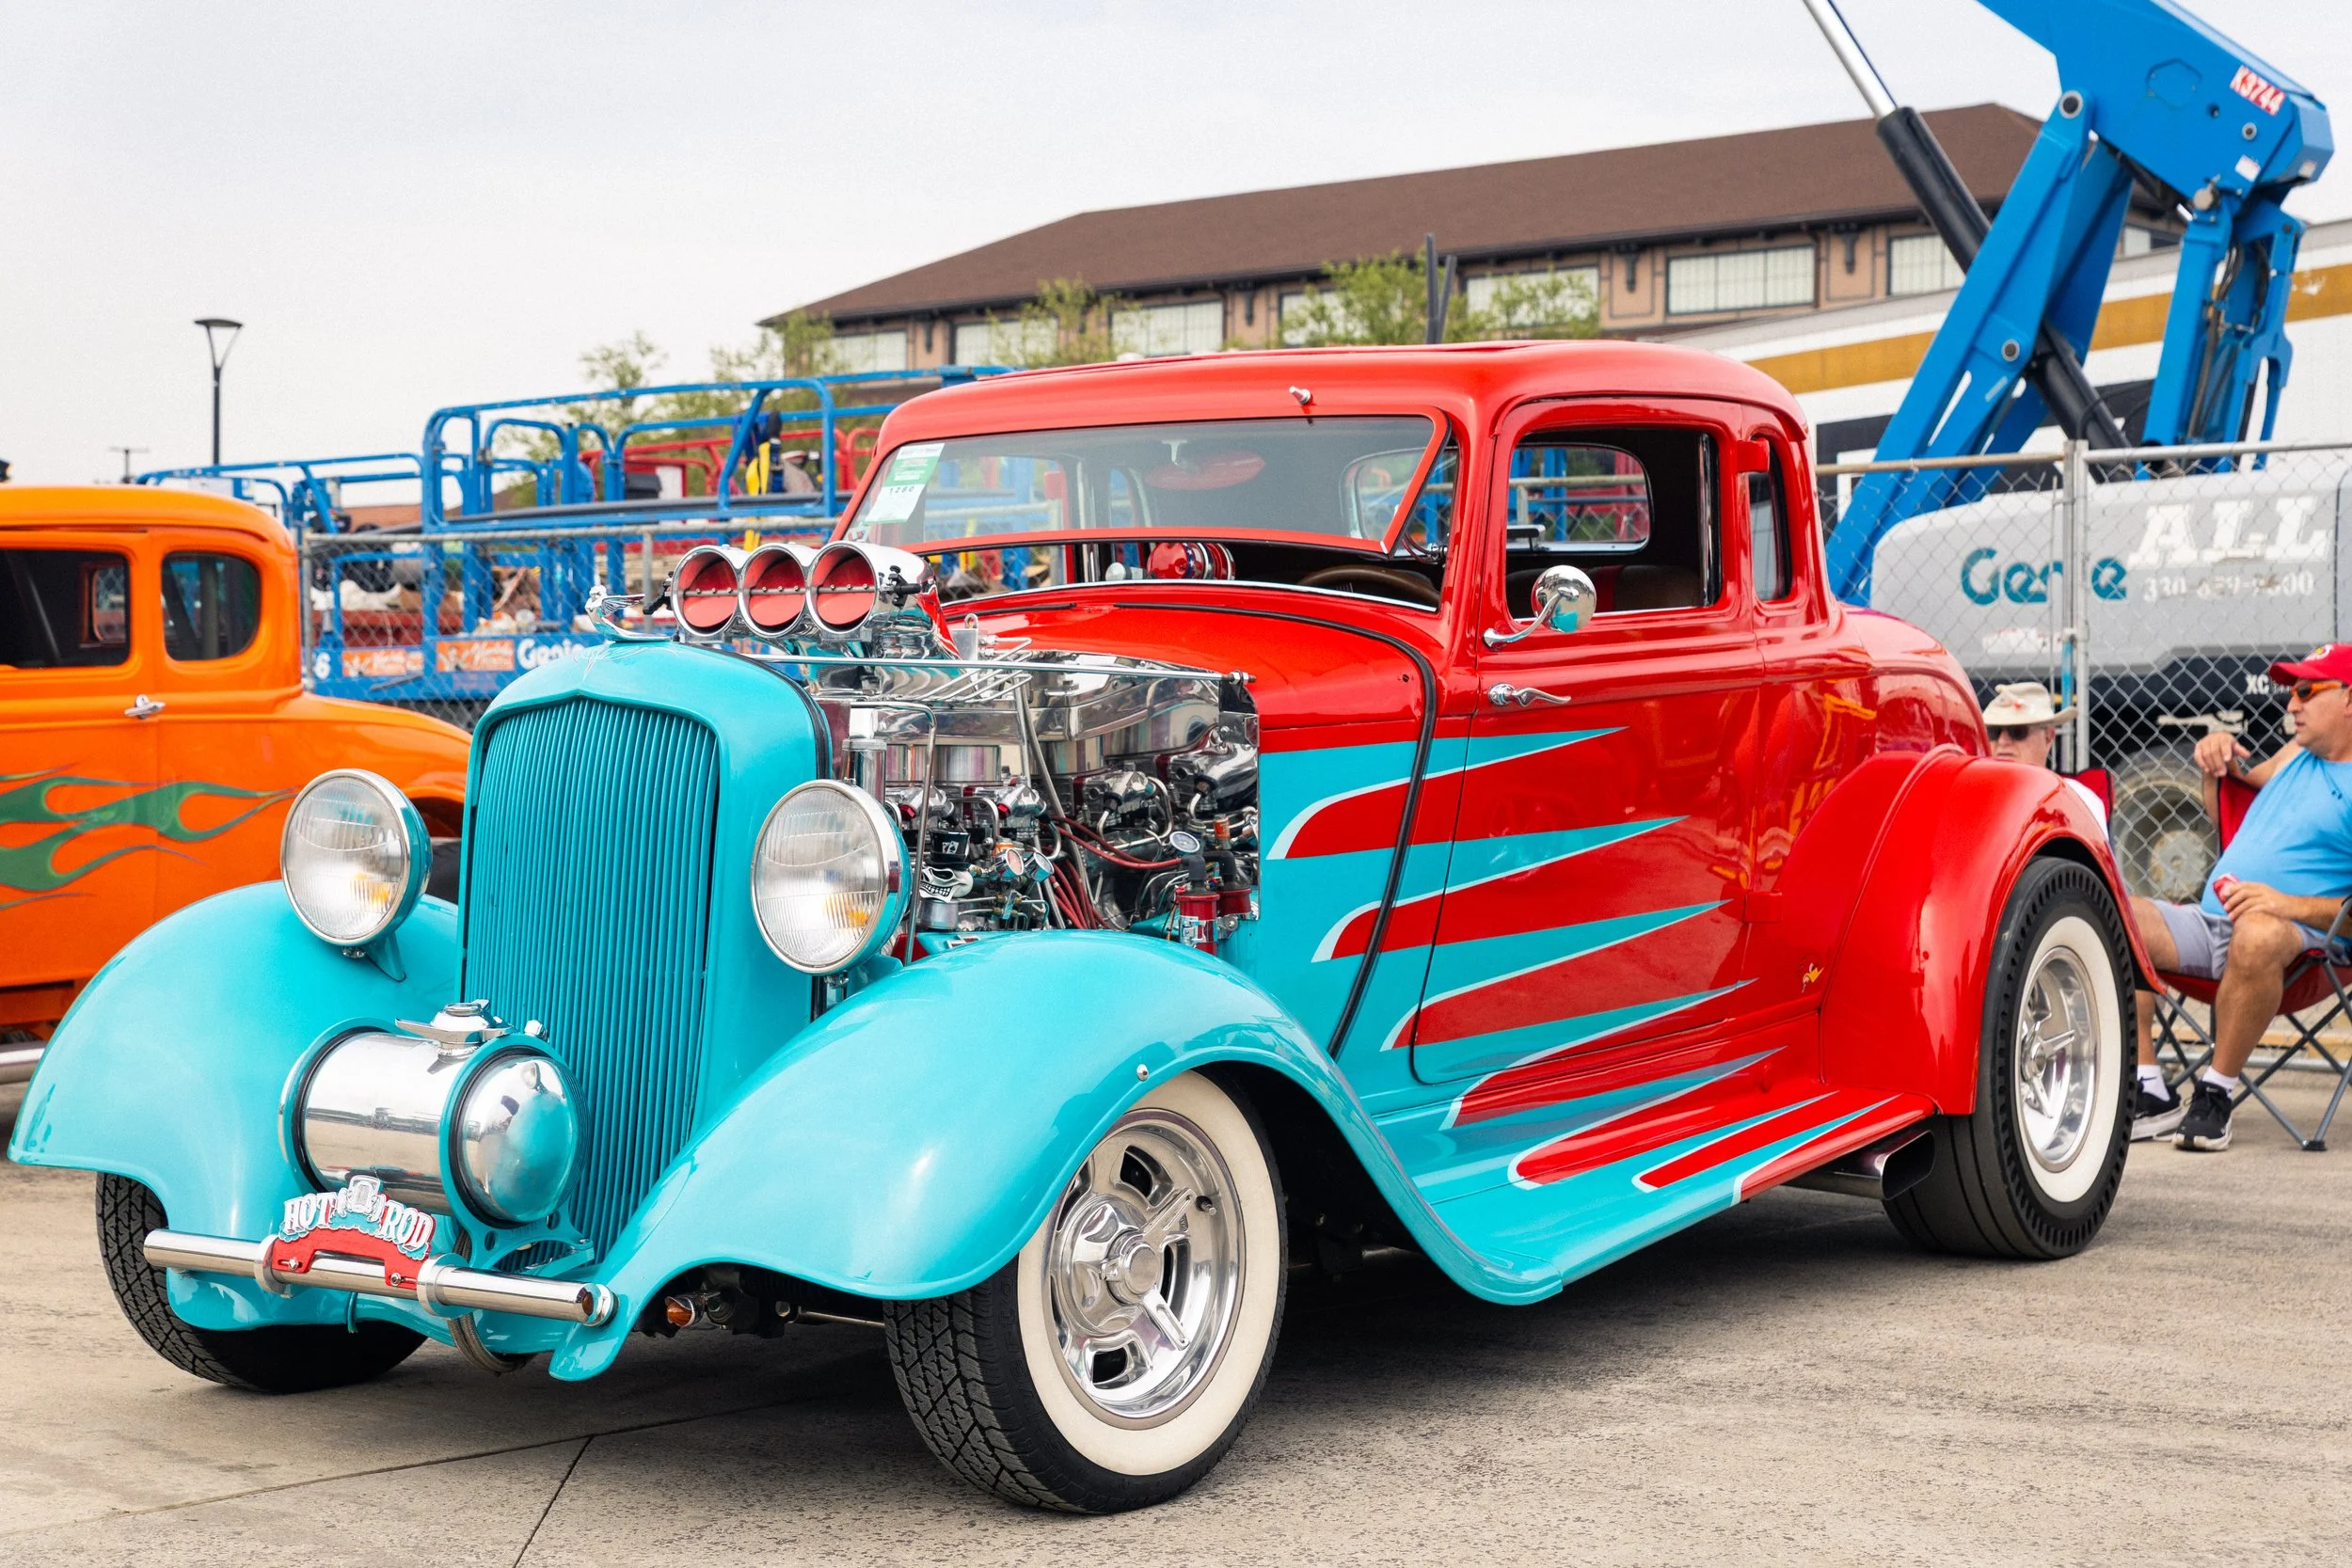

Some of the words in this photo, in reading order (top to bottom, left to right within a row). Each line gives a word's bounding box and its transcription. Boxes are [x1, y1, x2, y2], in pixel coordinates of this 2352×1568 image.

[2128, 498, 2332, 566] ALL
[1961, 546, 2128, 606] Gene
[2245, 673, 2269, 694] XC
[283, 1192, 338, 1236] HOT
[378, 1198, 436, 1252] ROD
